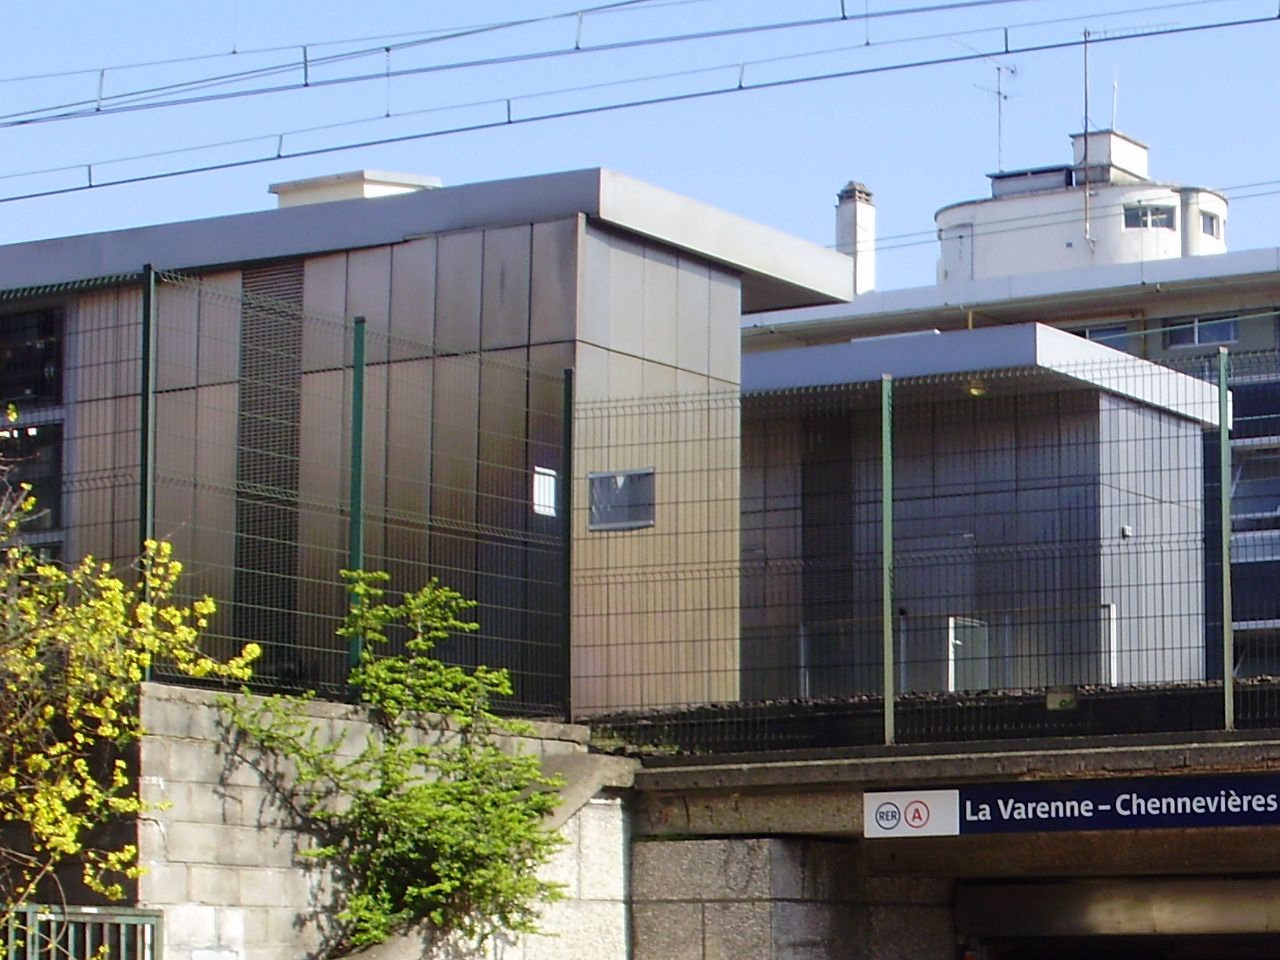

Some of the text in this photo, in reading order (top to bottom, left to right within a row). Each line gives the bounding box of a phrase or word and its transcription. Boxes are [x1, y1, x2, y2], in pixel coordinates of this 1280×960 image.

[878, 807, 923, 822] RER A
[965, 800, 992, 821] La
[997, 798, 1094, 820] Varenne
[1115, 789, 1278, 816] Chennevières
